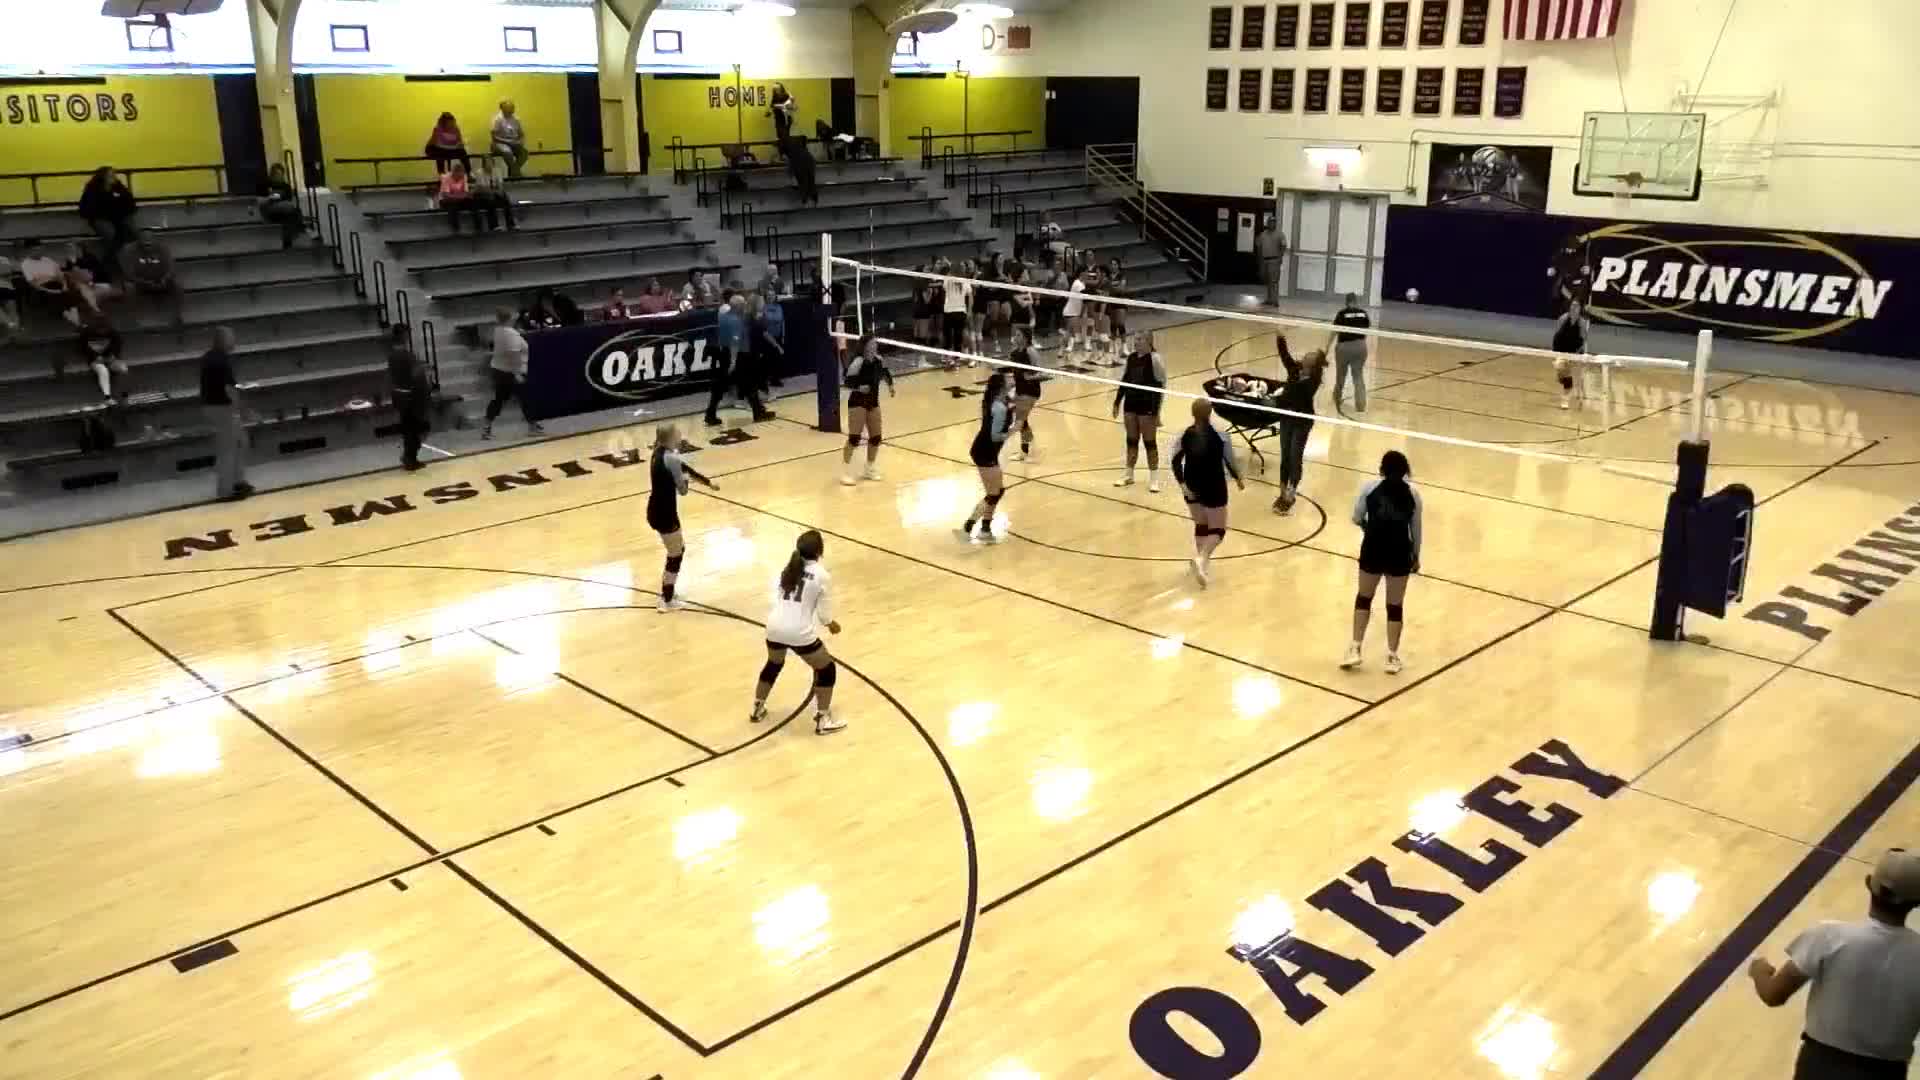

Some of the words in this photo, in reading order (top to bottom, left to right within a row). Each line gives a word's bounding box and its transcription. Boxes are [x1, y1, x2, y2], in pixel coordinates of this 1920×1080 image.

[0, 93, 139, 124] SITORS
[708, 86, 767, 108] HOME
[1592, 256, 1893, 319] PLAINSMEN
[602, 338, 720, 386] OAKL
[1742, 500, 1920, 642] PLAIN
[1129, 738, 1629, 1080] OAKLEY
